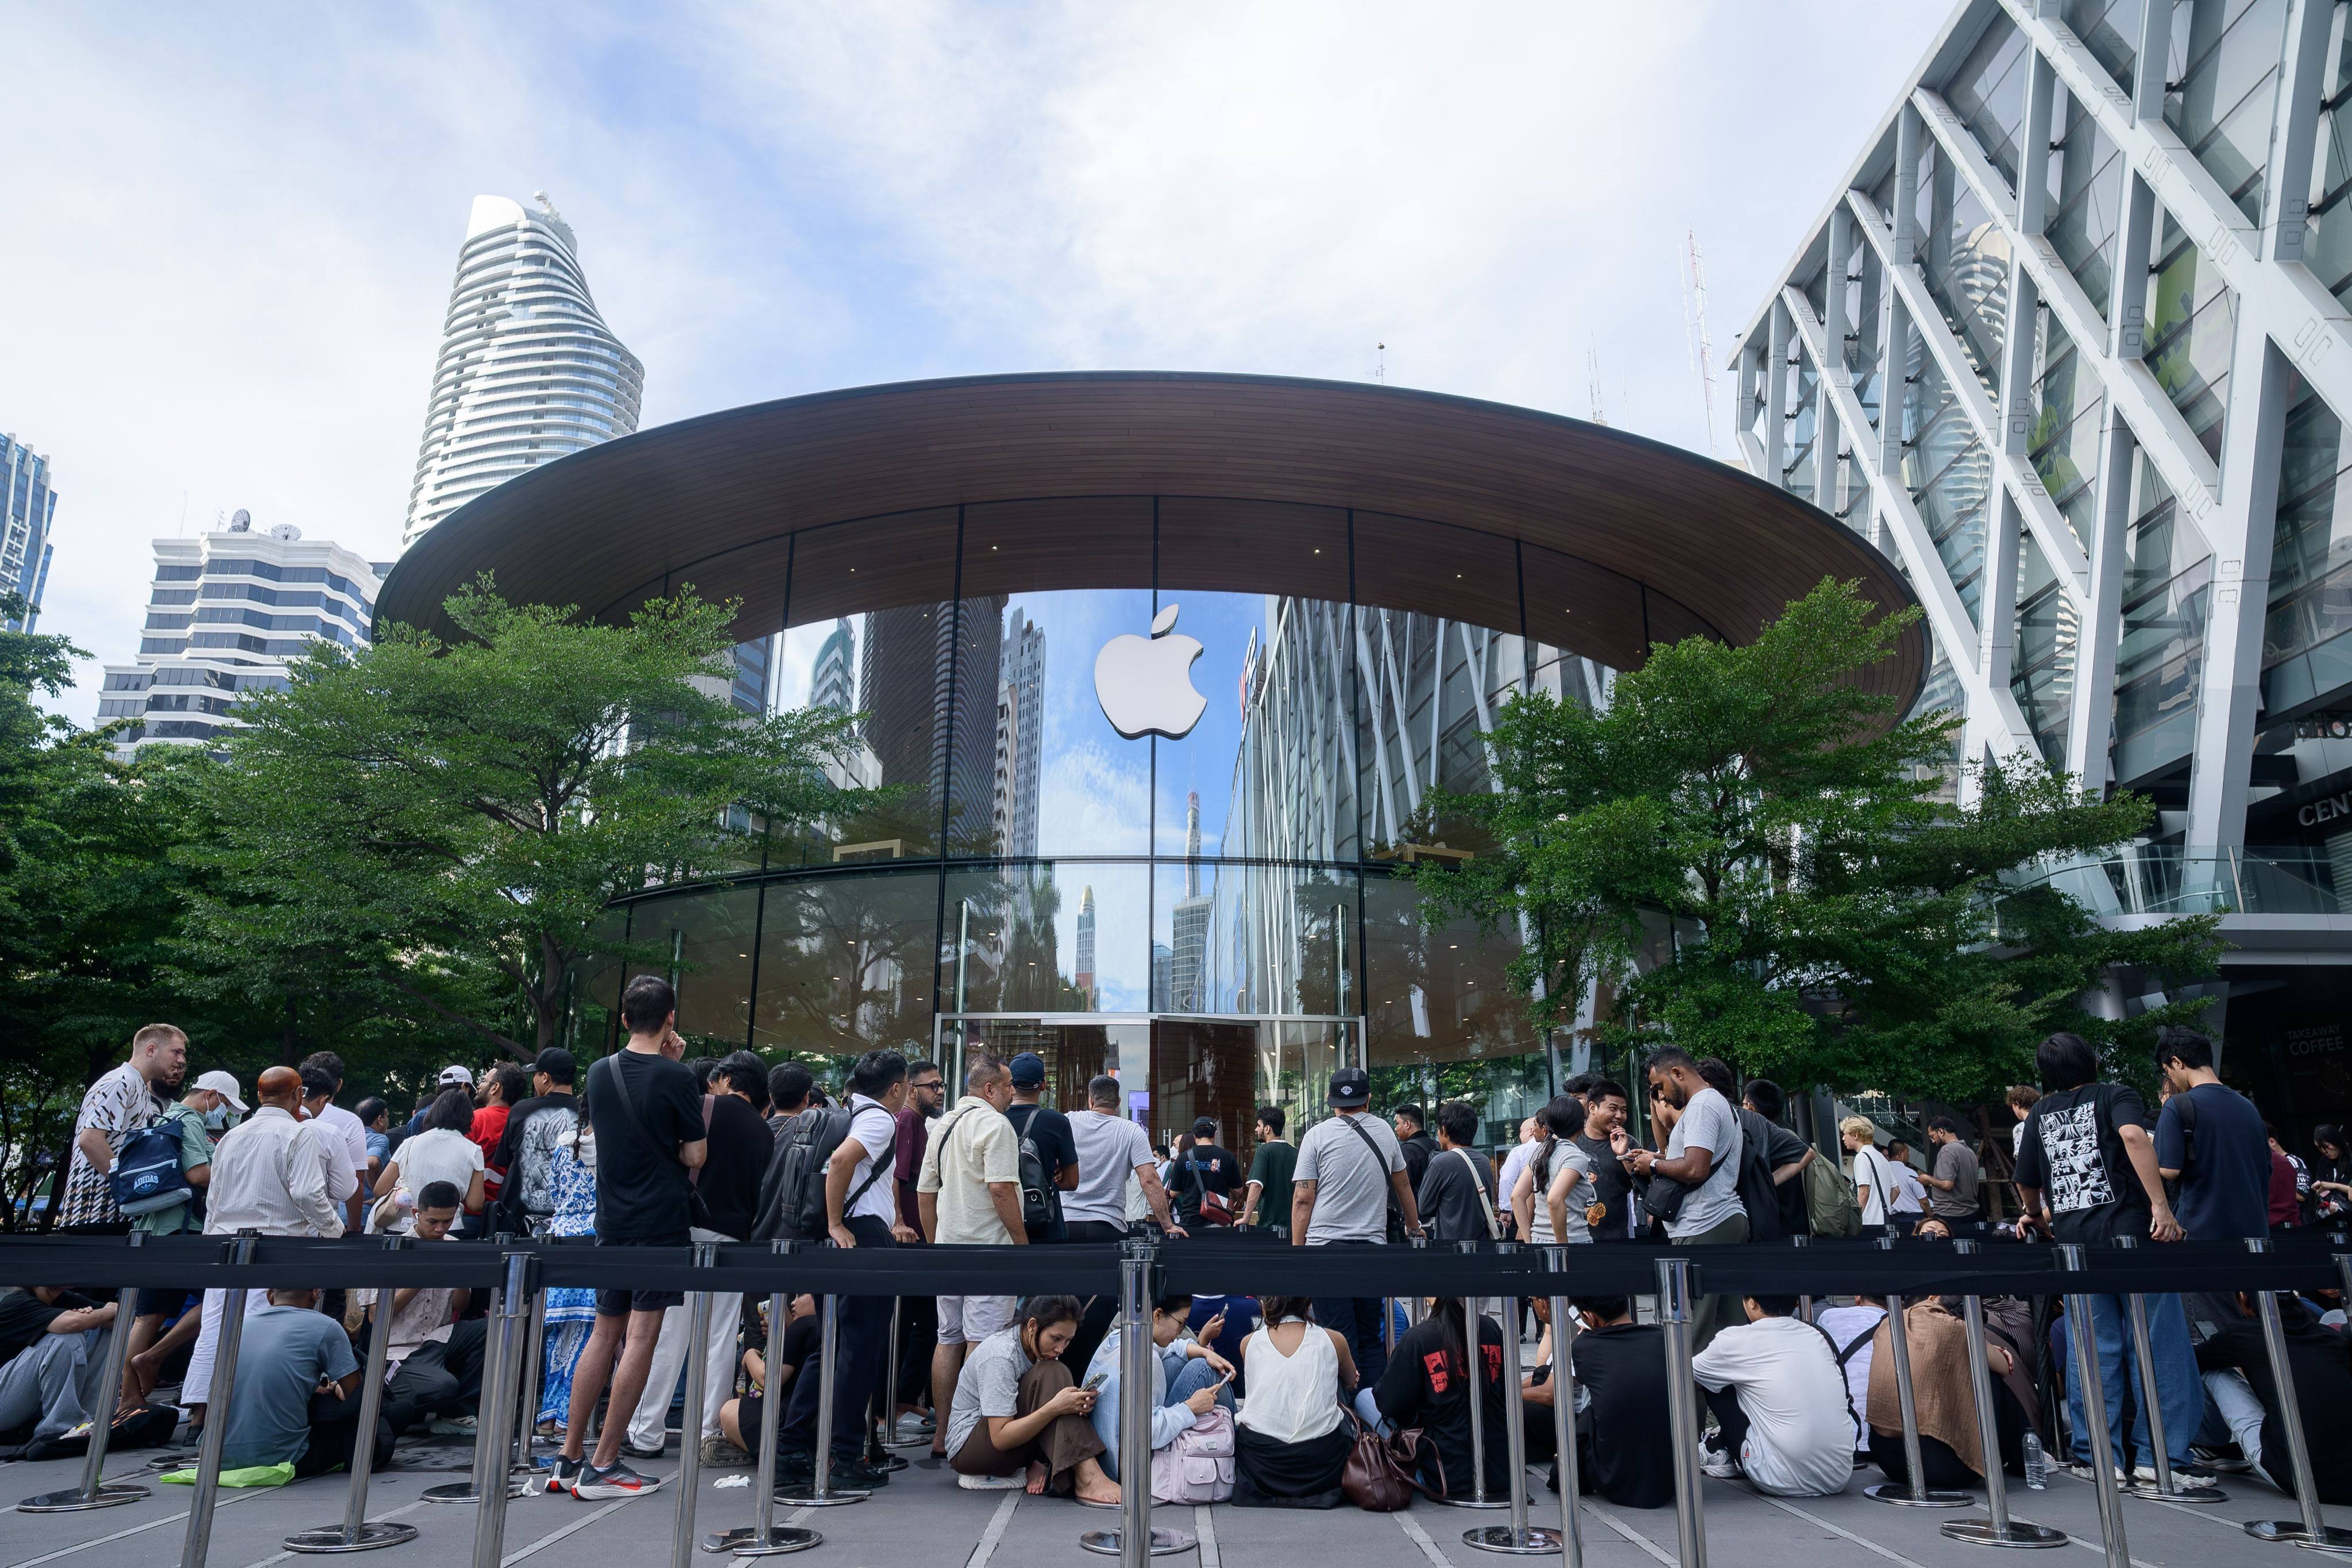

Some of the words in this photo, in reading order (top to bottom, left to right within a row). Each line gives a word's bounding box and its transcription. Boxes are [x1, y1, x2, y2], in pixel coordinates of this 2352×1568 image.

[2286, 1024, 2340, 1040] TAKEAWAY
[2289, 1036, 2345, 1056] COFFEE
[133, 1175, 159, 1190] ADIDAS
